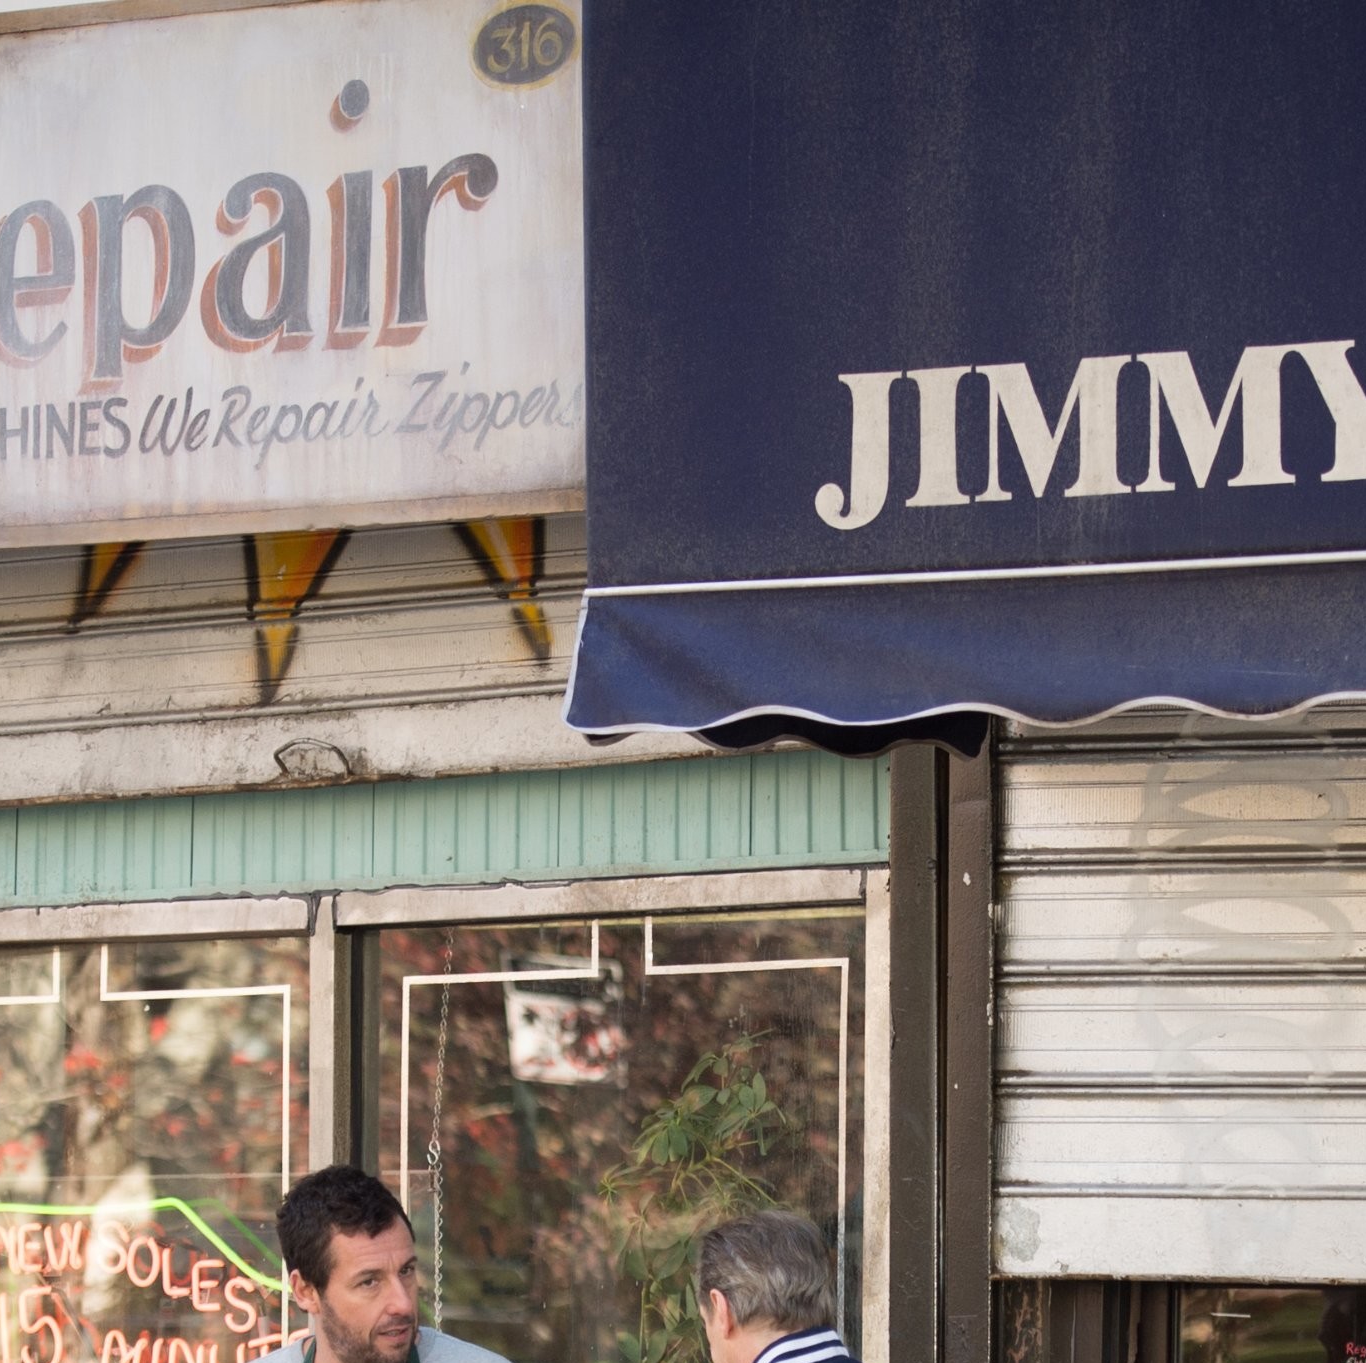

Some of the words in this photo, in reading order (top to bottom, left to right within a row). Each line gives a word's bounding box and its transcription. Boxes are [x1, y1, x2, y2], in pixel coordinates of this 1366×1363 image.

[487, 16, 564, 74] 316
[138, 386, 212, 458] We
[212, 376, 389, 471] Repair
[394, 361, 586, 453] Zippers
[96, 1219, 259, 1335] SOLES
